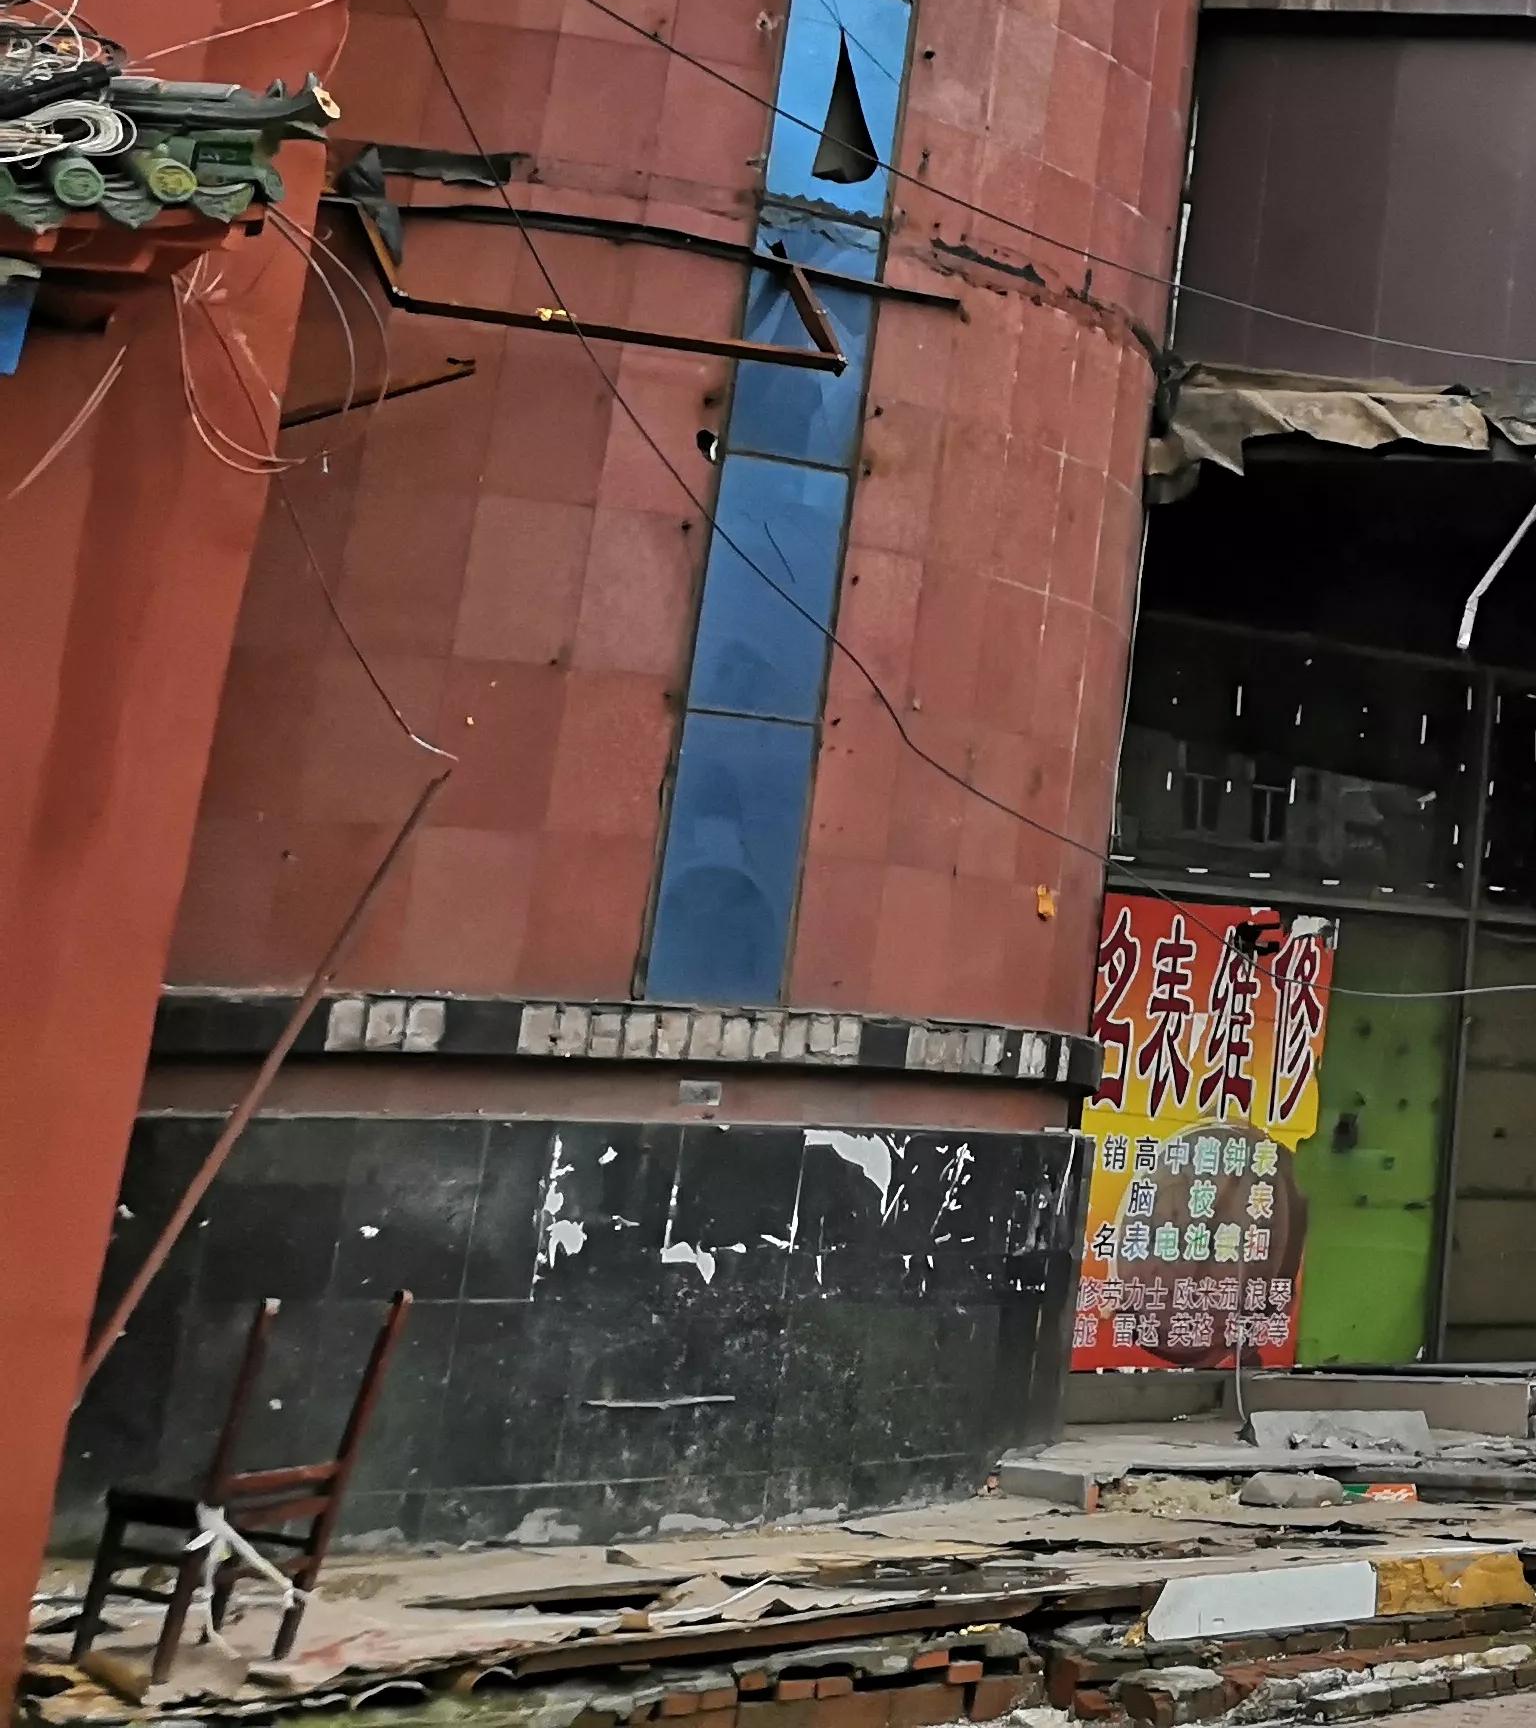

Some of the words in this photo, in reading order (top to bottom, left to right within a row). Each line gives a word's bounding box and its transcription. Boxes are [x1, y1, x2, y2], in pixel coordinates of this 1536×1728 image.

[1089, 907, 1323, 1126] 名表维修
[1088, 1135, 1277, 1177] 销高中档钟表
